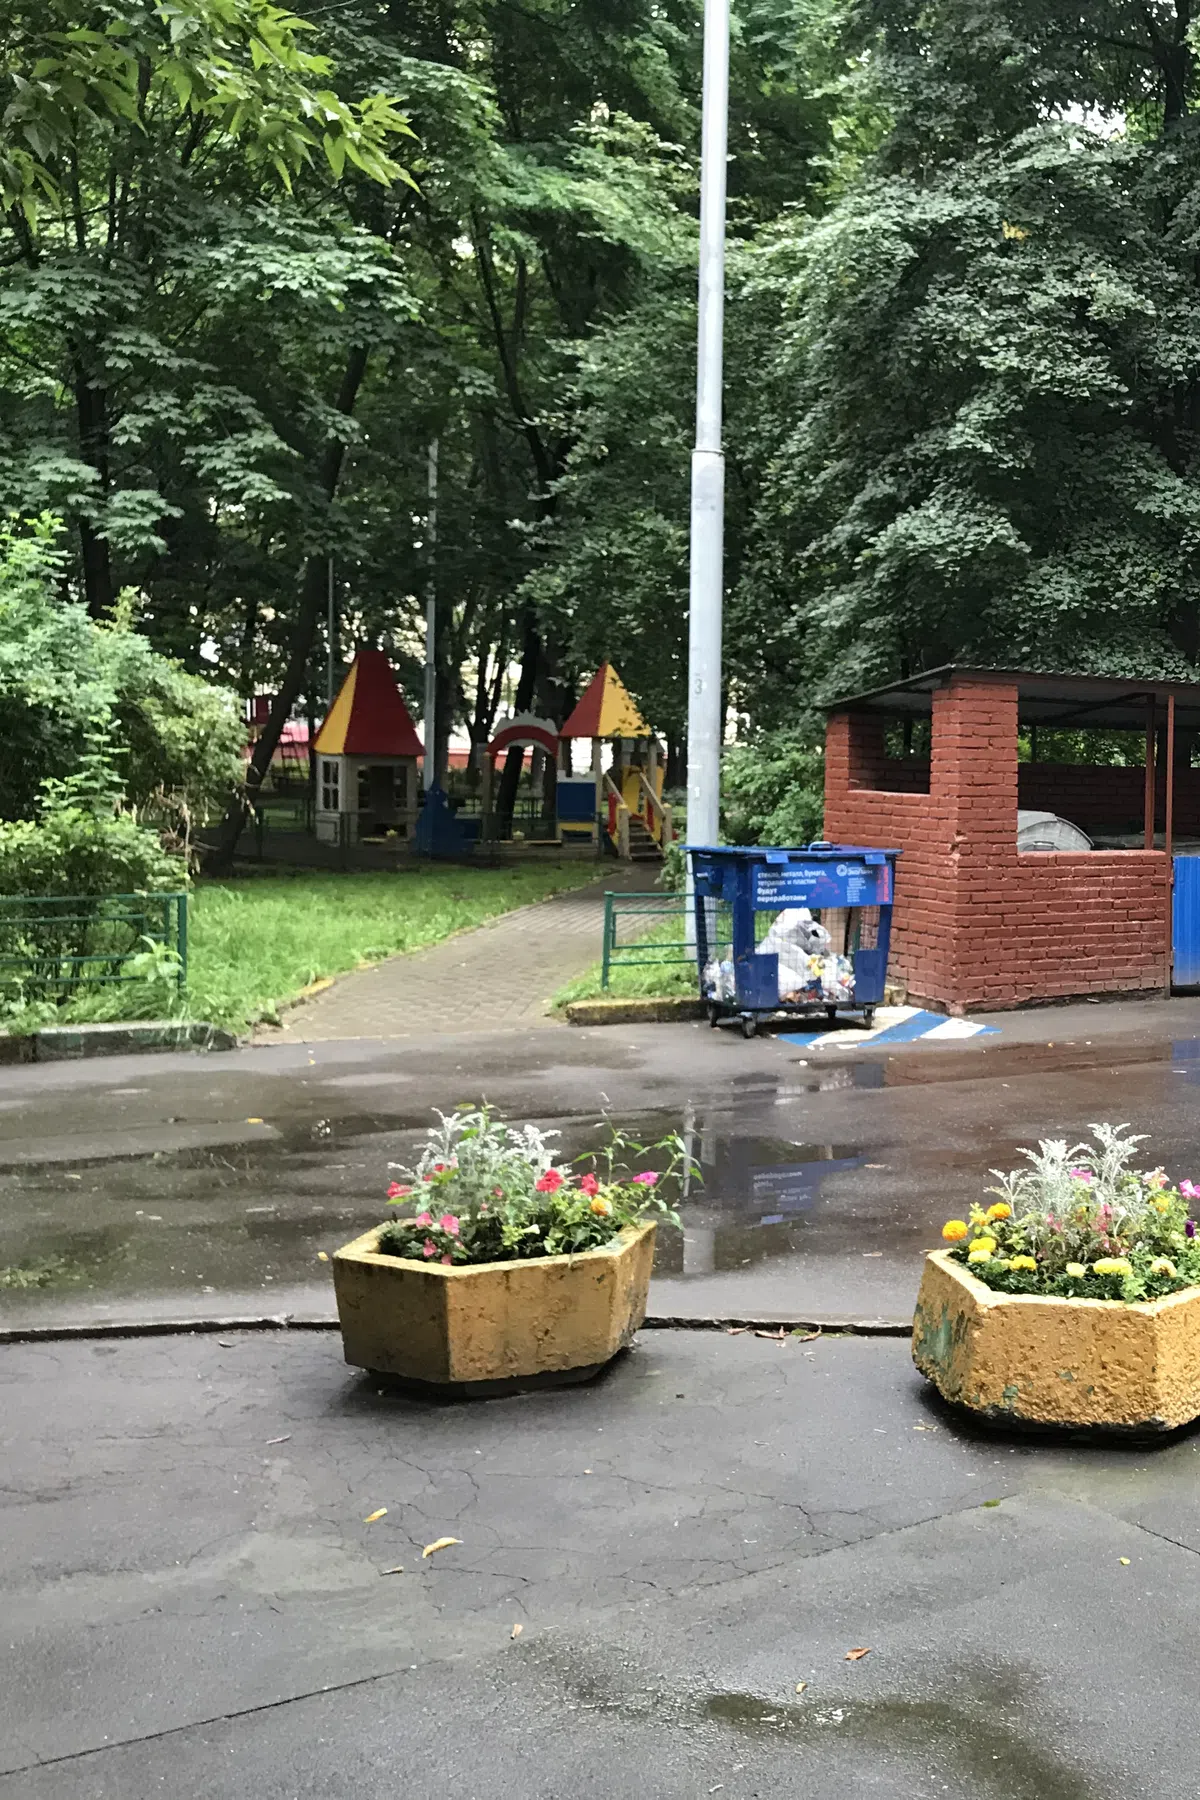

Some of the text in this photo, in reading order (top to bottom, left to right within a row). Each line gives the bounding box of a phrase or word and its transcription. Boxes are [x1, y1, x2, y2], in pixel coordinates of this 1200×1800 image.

[804, 869, 827, 878] бумага,
[757, 887, 778, 895] будут
[757, 894, 807, 903] переработаны
